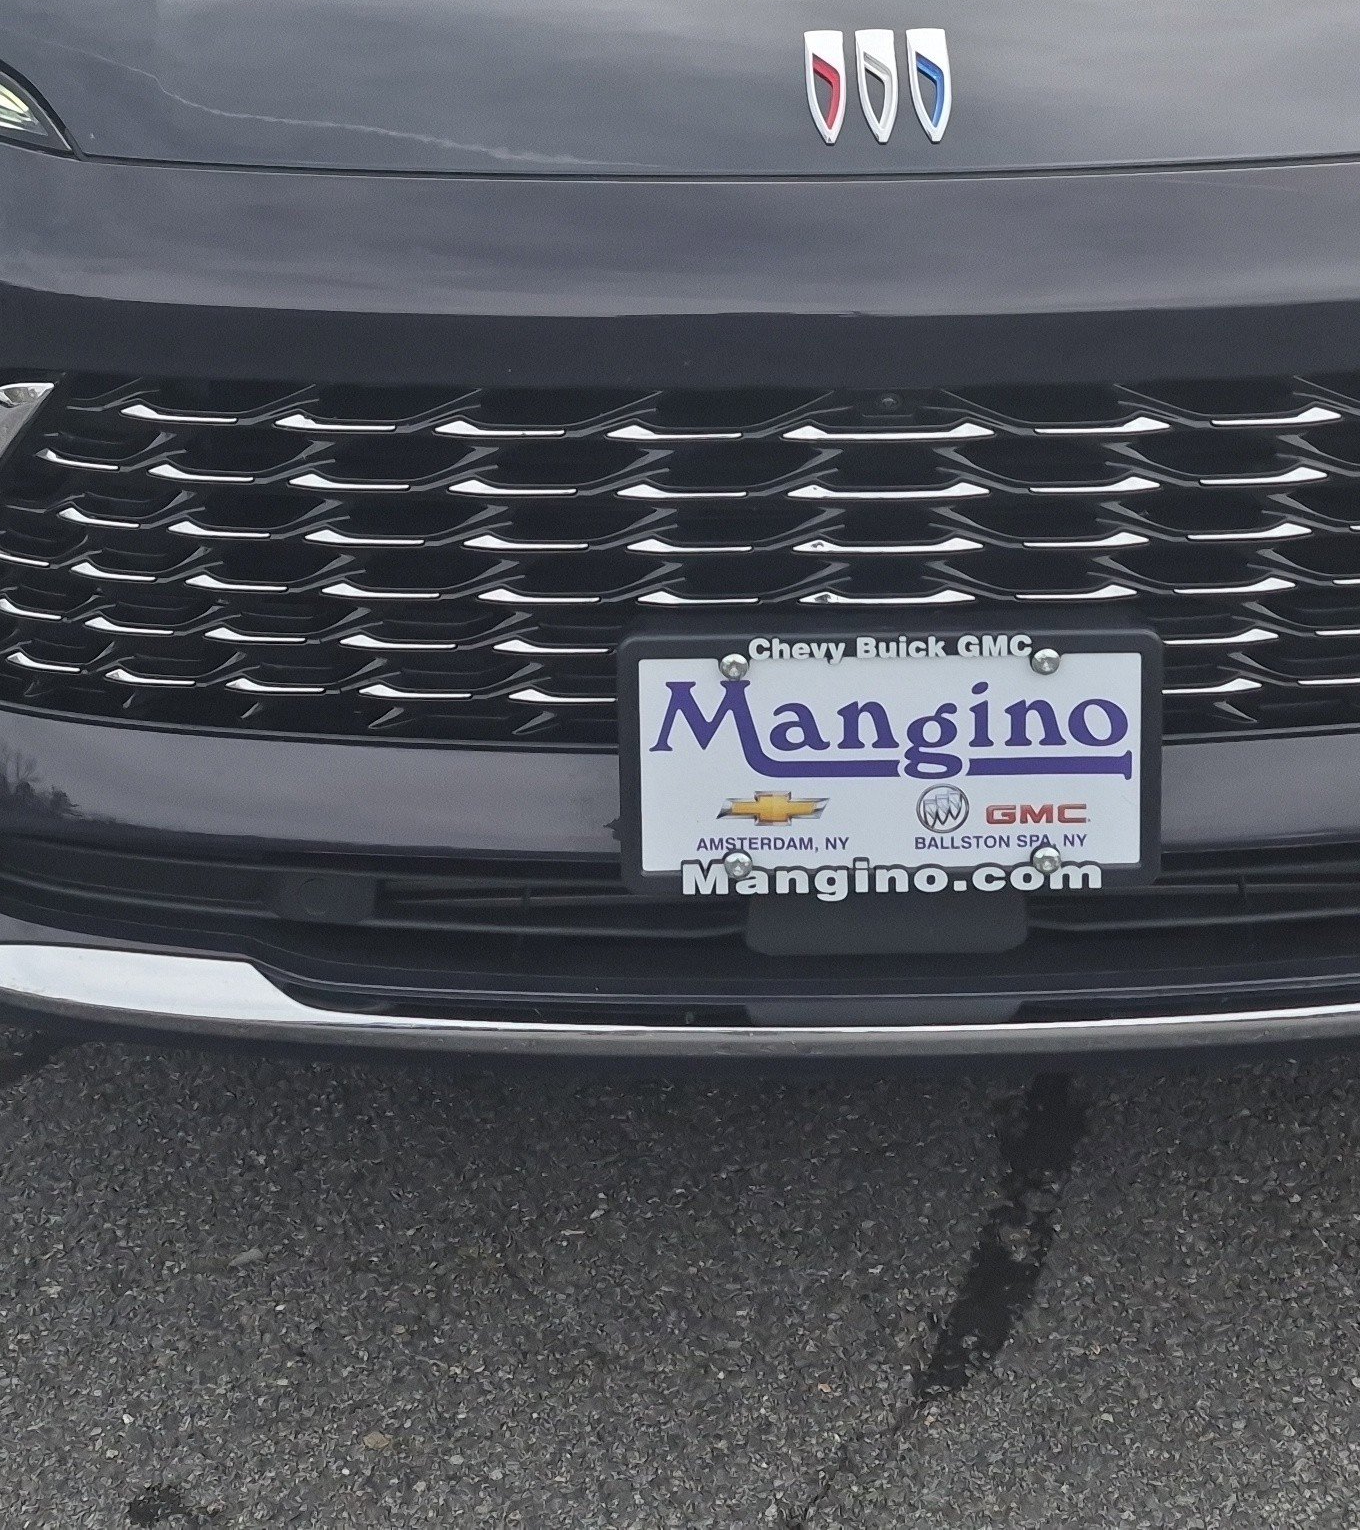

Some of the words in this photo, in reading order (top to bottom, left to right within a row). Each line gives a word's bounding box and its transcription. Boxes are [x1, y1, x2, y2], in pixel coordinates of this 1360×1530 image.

[748, 637, 845, 665] Chevy
[856, 635, 946, 659] Buick
[957, 634, 1032, 658] GMC
[649, 680, 1130, 779] Mangino
[986, 803, 1087, 825] GMC
[696, 837, 820, 853] AMSTERDAM,
[825, 837, 850, 851] NY
[914, 835, 1011, 850] BALLSTON
[1063, 834, 1088, 847] NY
[682, 860, 1102, 902] Mangino.com
